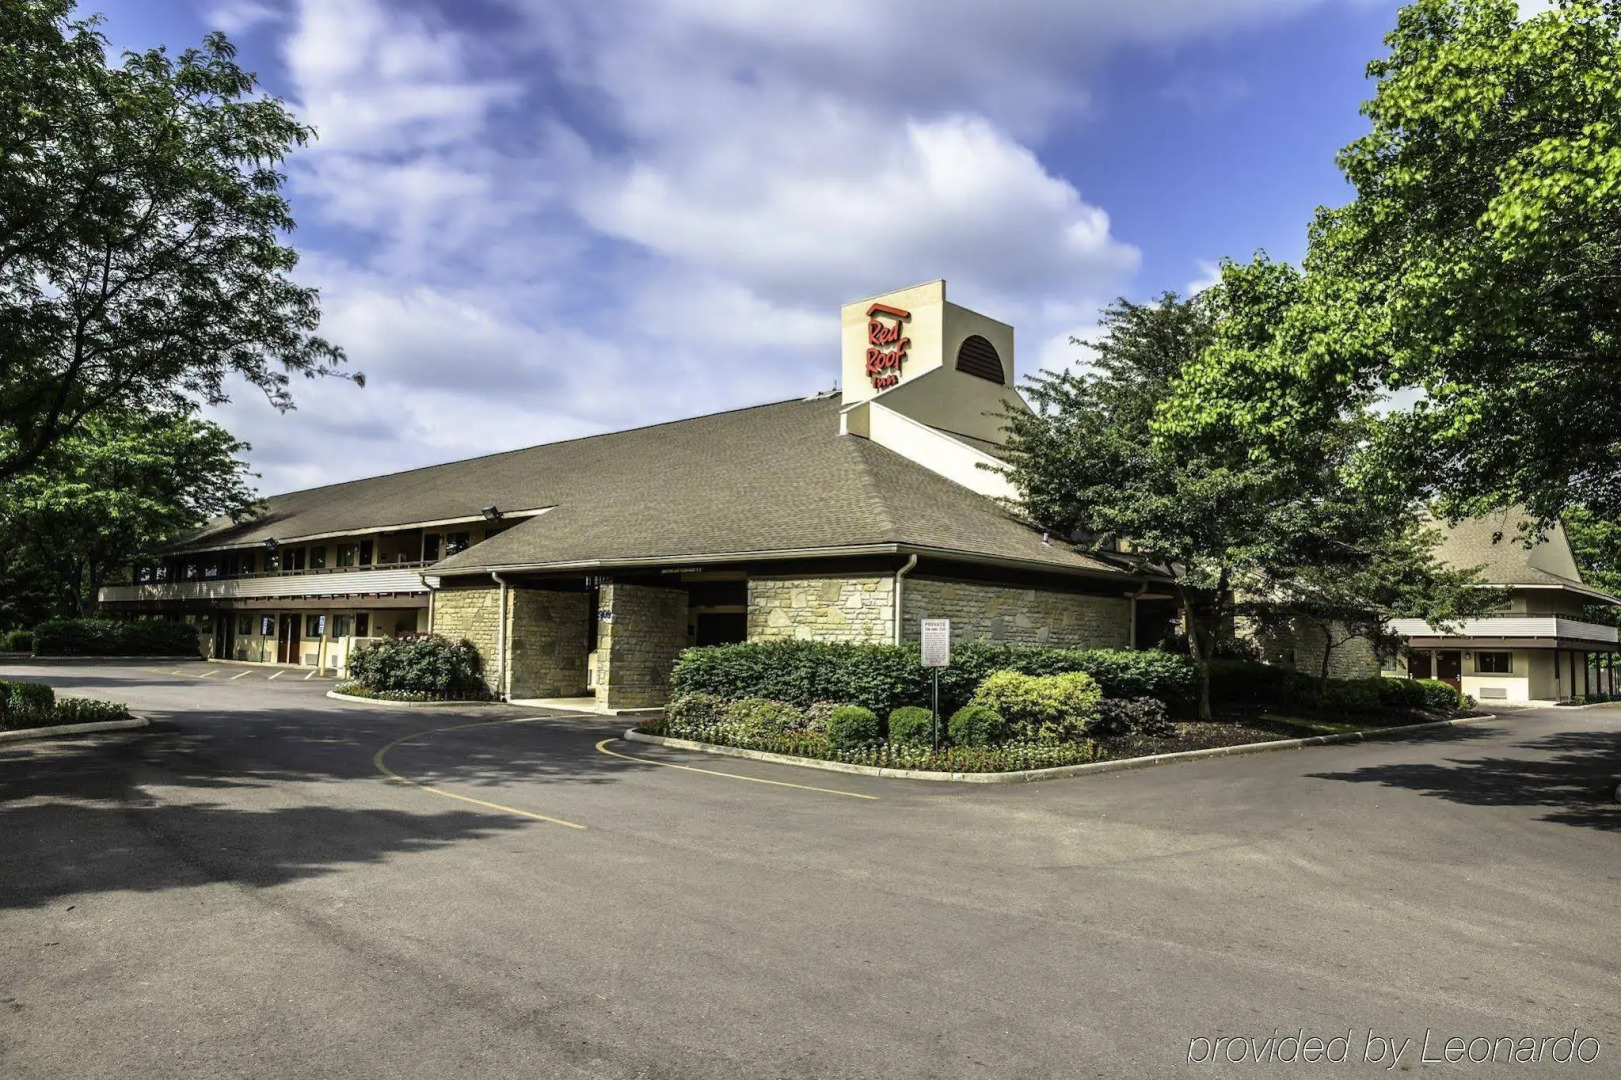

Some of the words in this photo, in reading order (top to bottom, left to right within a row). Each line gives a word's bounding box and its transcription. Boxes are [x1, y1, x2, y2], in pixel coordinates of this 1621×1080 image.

[868, 319, 903, 345] Red
[866, 337, 911, 376] Roof
[872, 374, 899, 388] Inn
